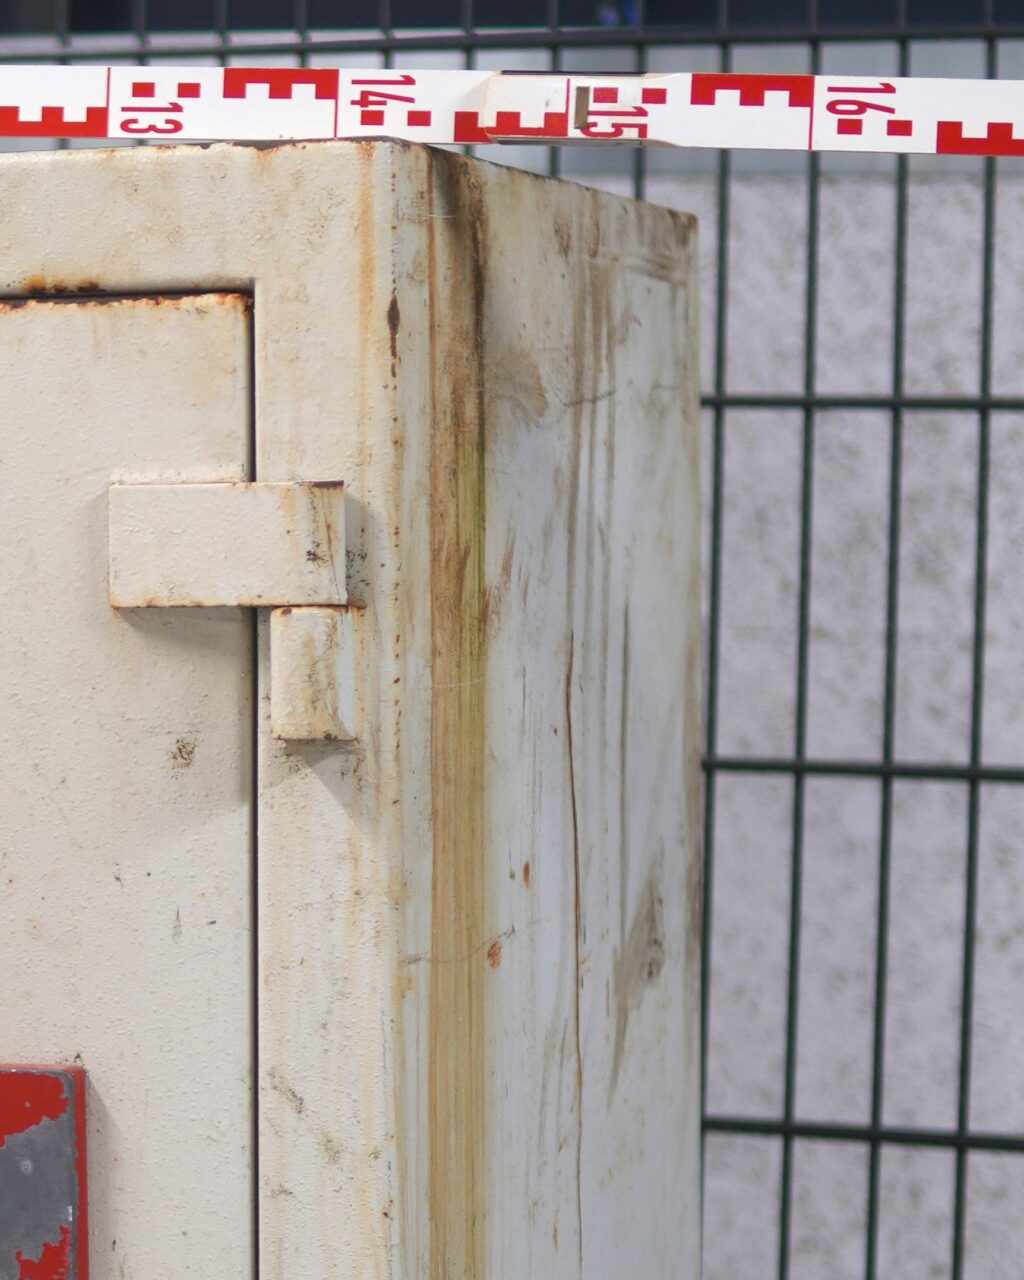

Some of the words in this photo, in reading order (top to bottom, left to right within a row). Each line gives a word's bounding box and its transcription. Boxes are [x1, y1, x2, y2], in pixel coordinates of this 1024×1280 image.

[120, 102, 184, 135] 13
[350, 75, 417, 107] 14
[580, 105, 649, 139] 15
[826, 82, 897, 116] 16
